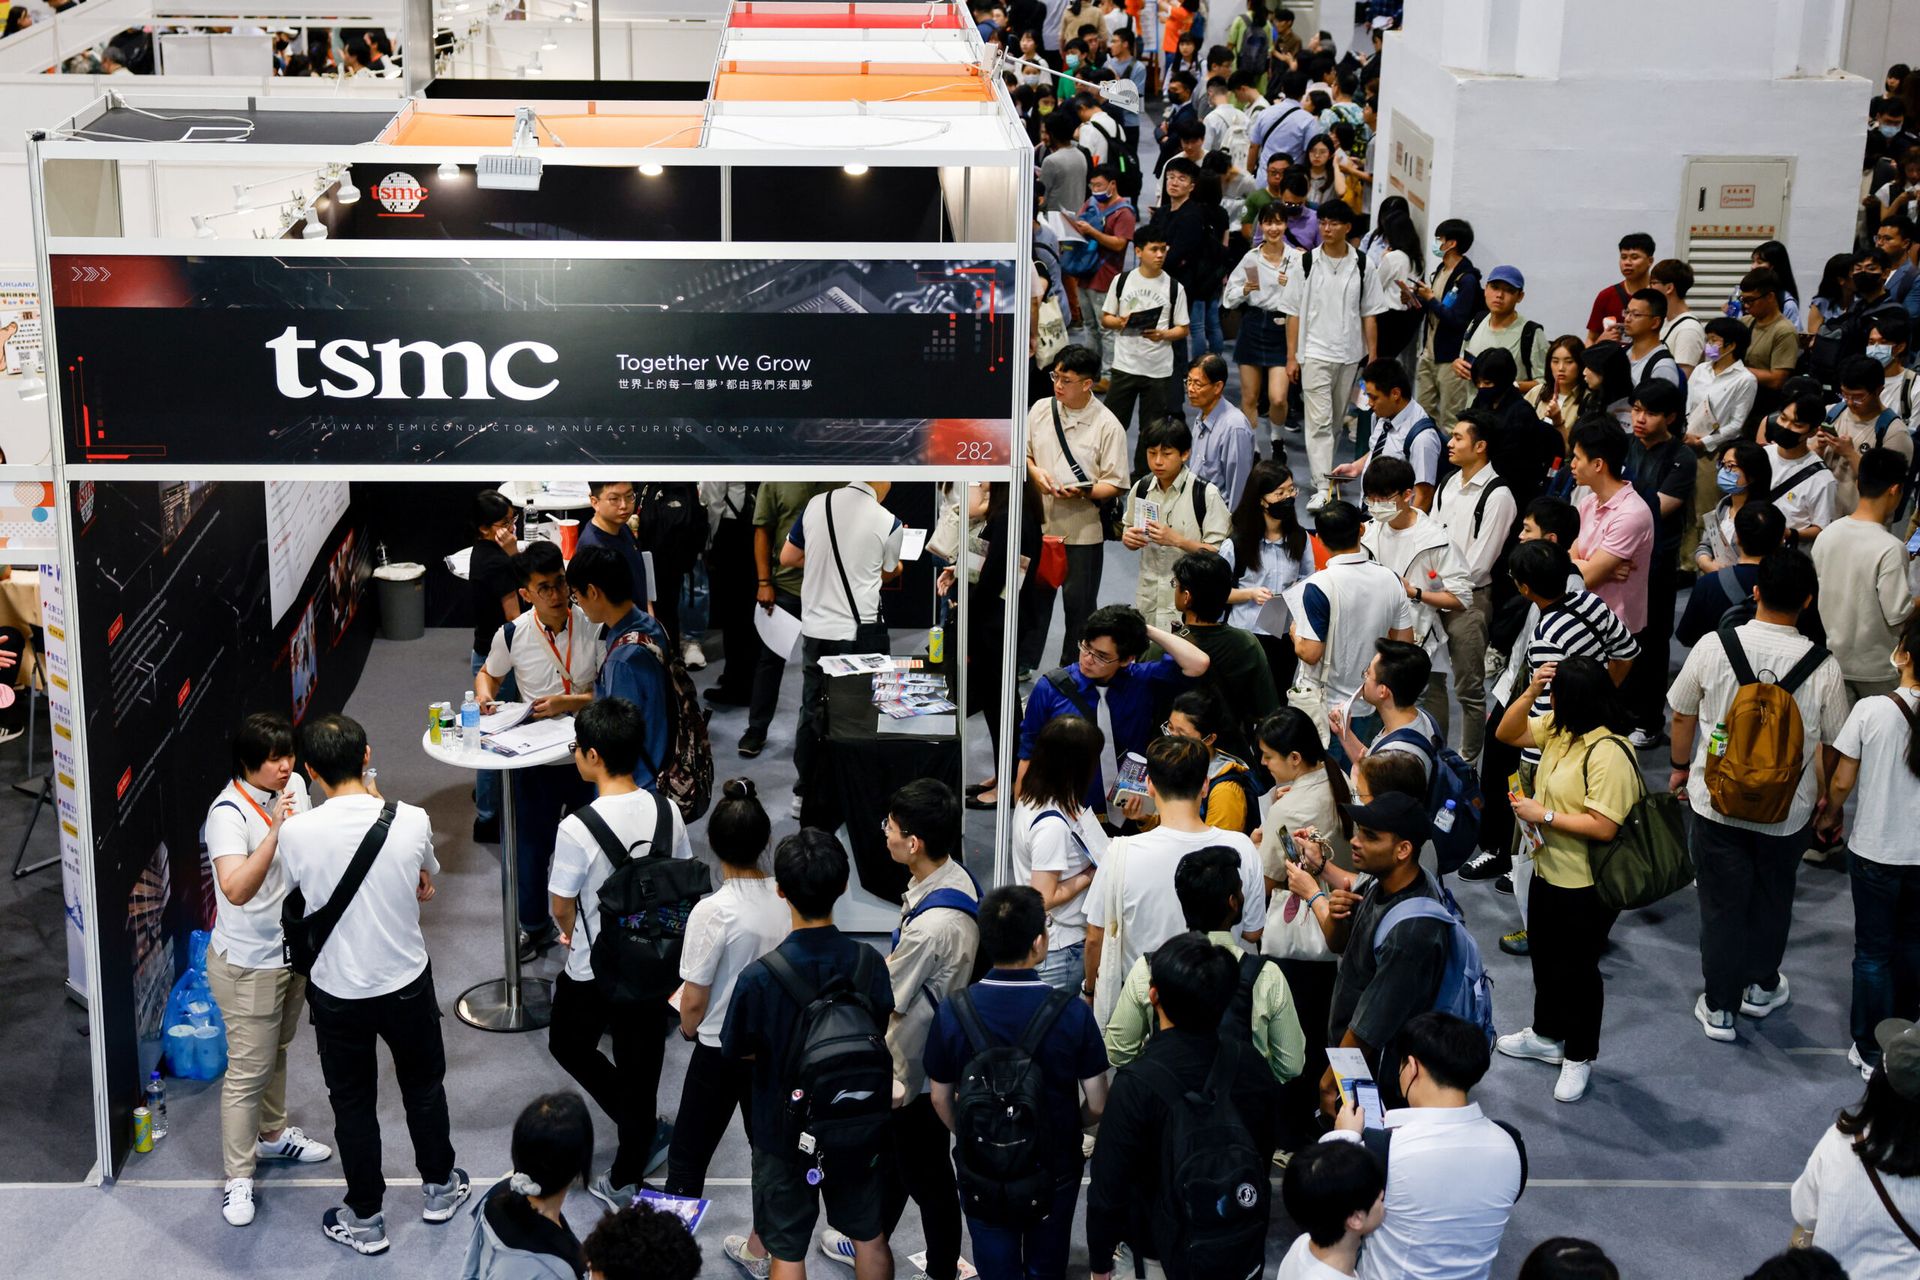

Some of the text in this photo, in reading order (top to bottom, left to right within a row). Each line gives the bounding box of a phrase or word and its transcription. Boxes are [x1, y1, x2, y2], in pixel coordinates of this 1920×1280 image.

[370, 185, 429, 200] tsmc
[265, 326, 560, 401] tsmc
[616, 354, 811, 374] Together We Grow
[311, 422, 785, 433] TAIWAN SEMICONDUCTOR MANUFACTURING COMPANY
[956, 441, 993, 460] 282
